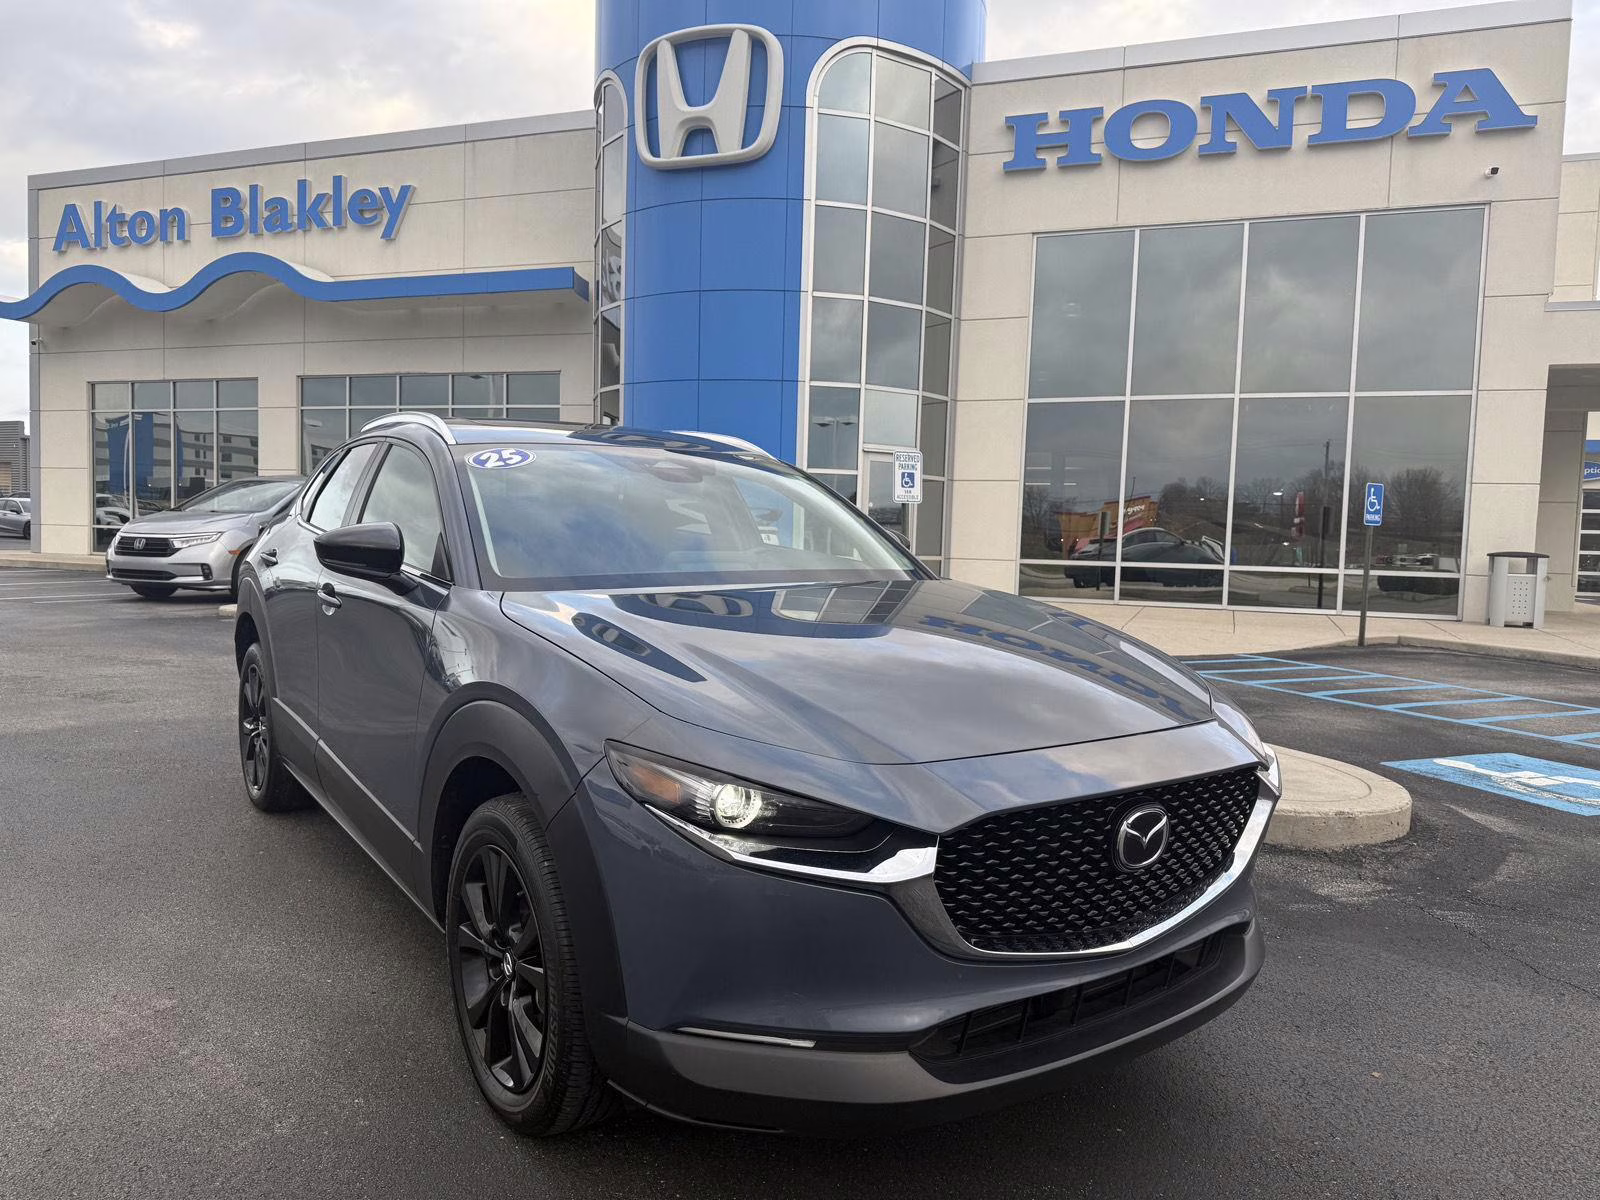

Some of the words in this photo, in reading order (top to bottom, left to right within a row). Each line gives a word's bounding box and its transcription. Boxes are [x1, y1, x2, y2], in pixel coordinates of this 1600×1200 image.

[1002, 67, 1538, 174] HONDA
[52, 200, 191, 253] Alton
[210, 174, 416, 242] Blakley
[479, 448, 523, 468] 25
[895, 453, 920, 463] RESERVED
[897, 463, 918, 471] PARKING
